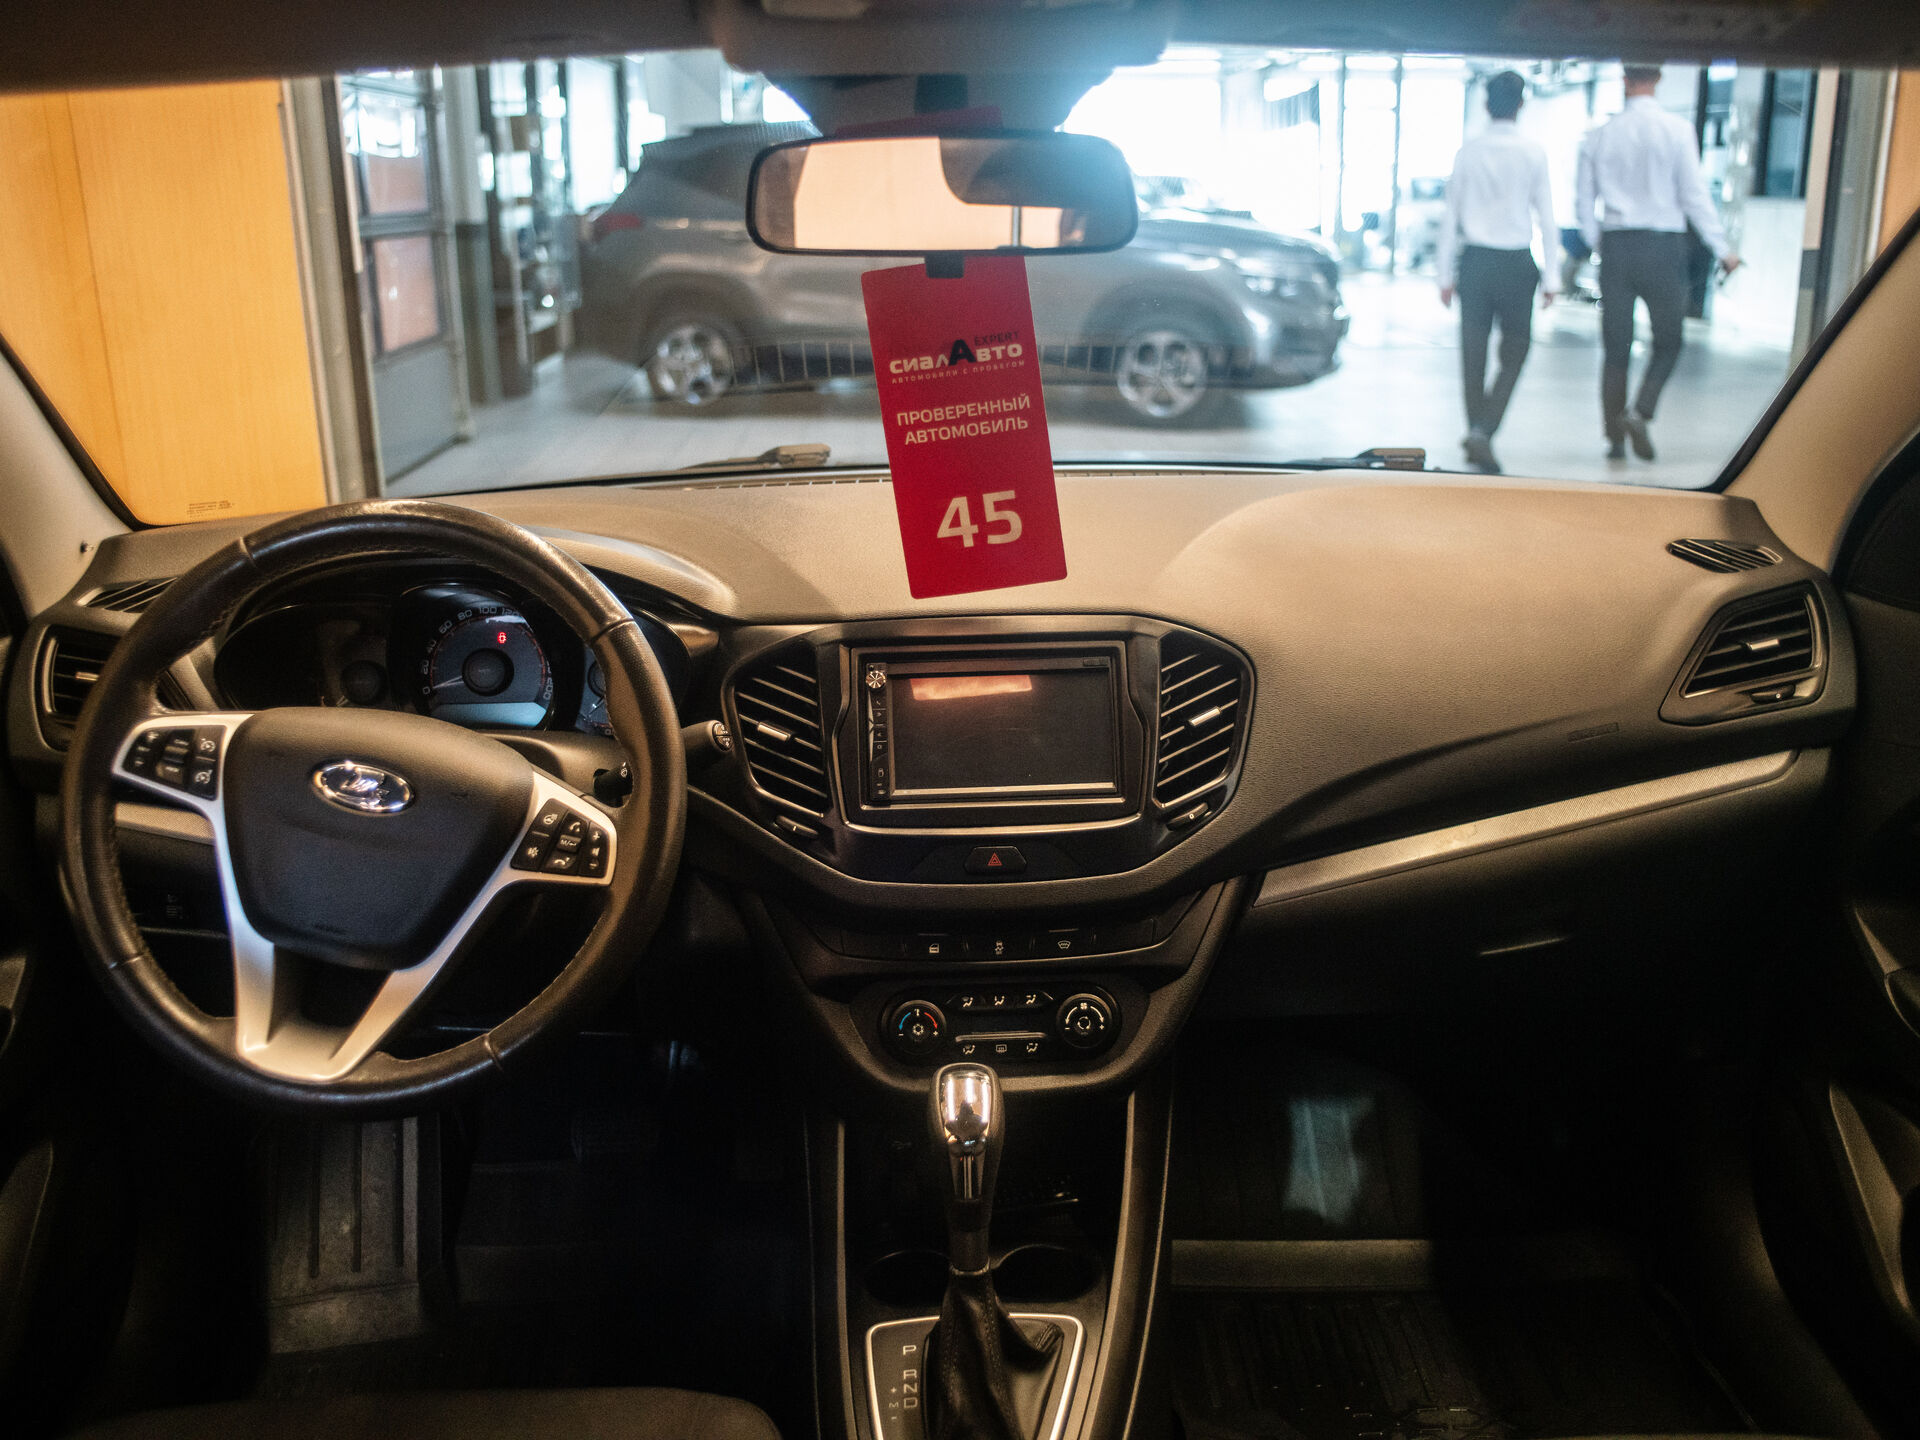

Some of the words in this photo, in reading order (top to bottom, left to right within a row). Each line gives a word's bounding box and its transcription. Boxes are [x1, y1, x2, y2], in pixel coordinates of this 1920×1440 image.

[974, 331, 1019, 346] EXPERT
[892, 369, 958, 384] АВТОМОБИЛИ
[973, 360, 1025, 373] ПРОБЕГОМ
[896, 393, 1031, 427] ПРОВЕРЕННЫЙ
[905, 417, 1029, 445] АВТОМОБИЛЬ
[936, 489, 1023, 548] 45
[457, 610, 472, 620] 80
[479, 606, 497, 614] 100
[903, 1345, 916, 1355] P
[903, 1369, 917, 1380] R
[904, 1383, 917, 1393] N
[904, 1397, 917, 1408] D
